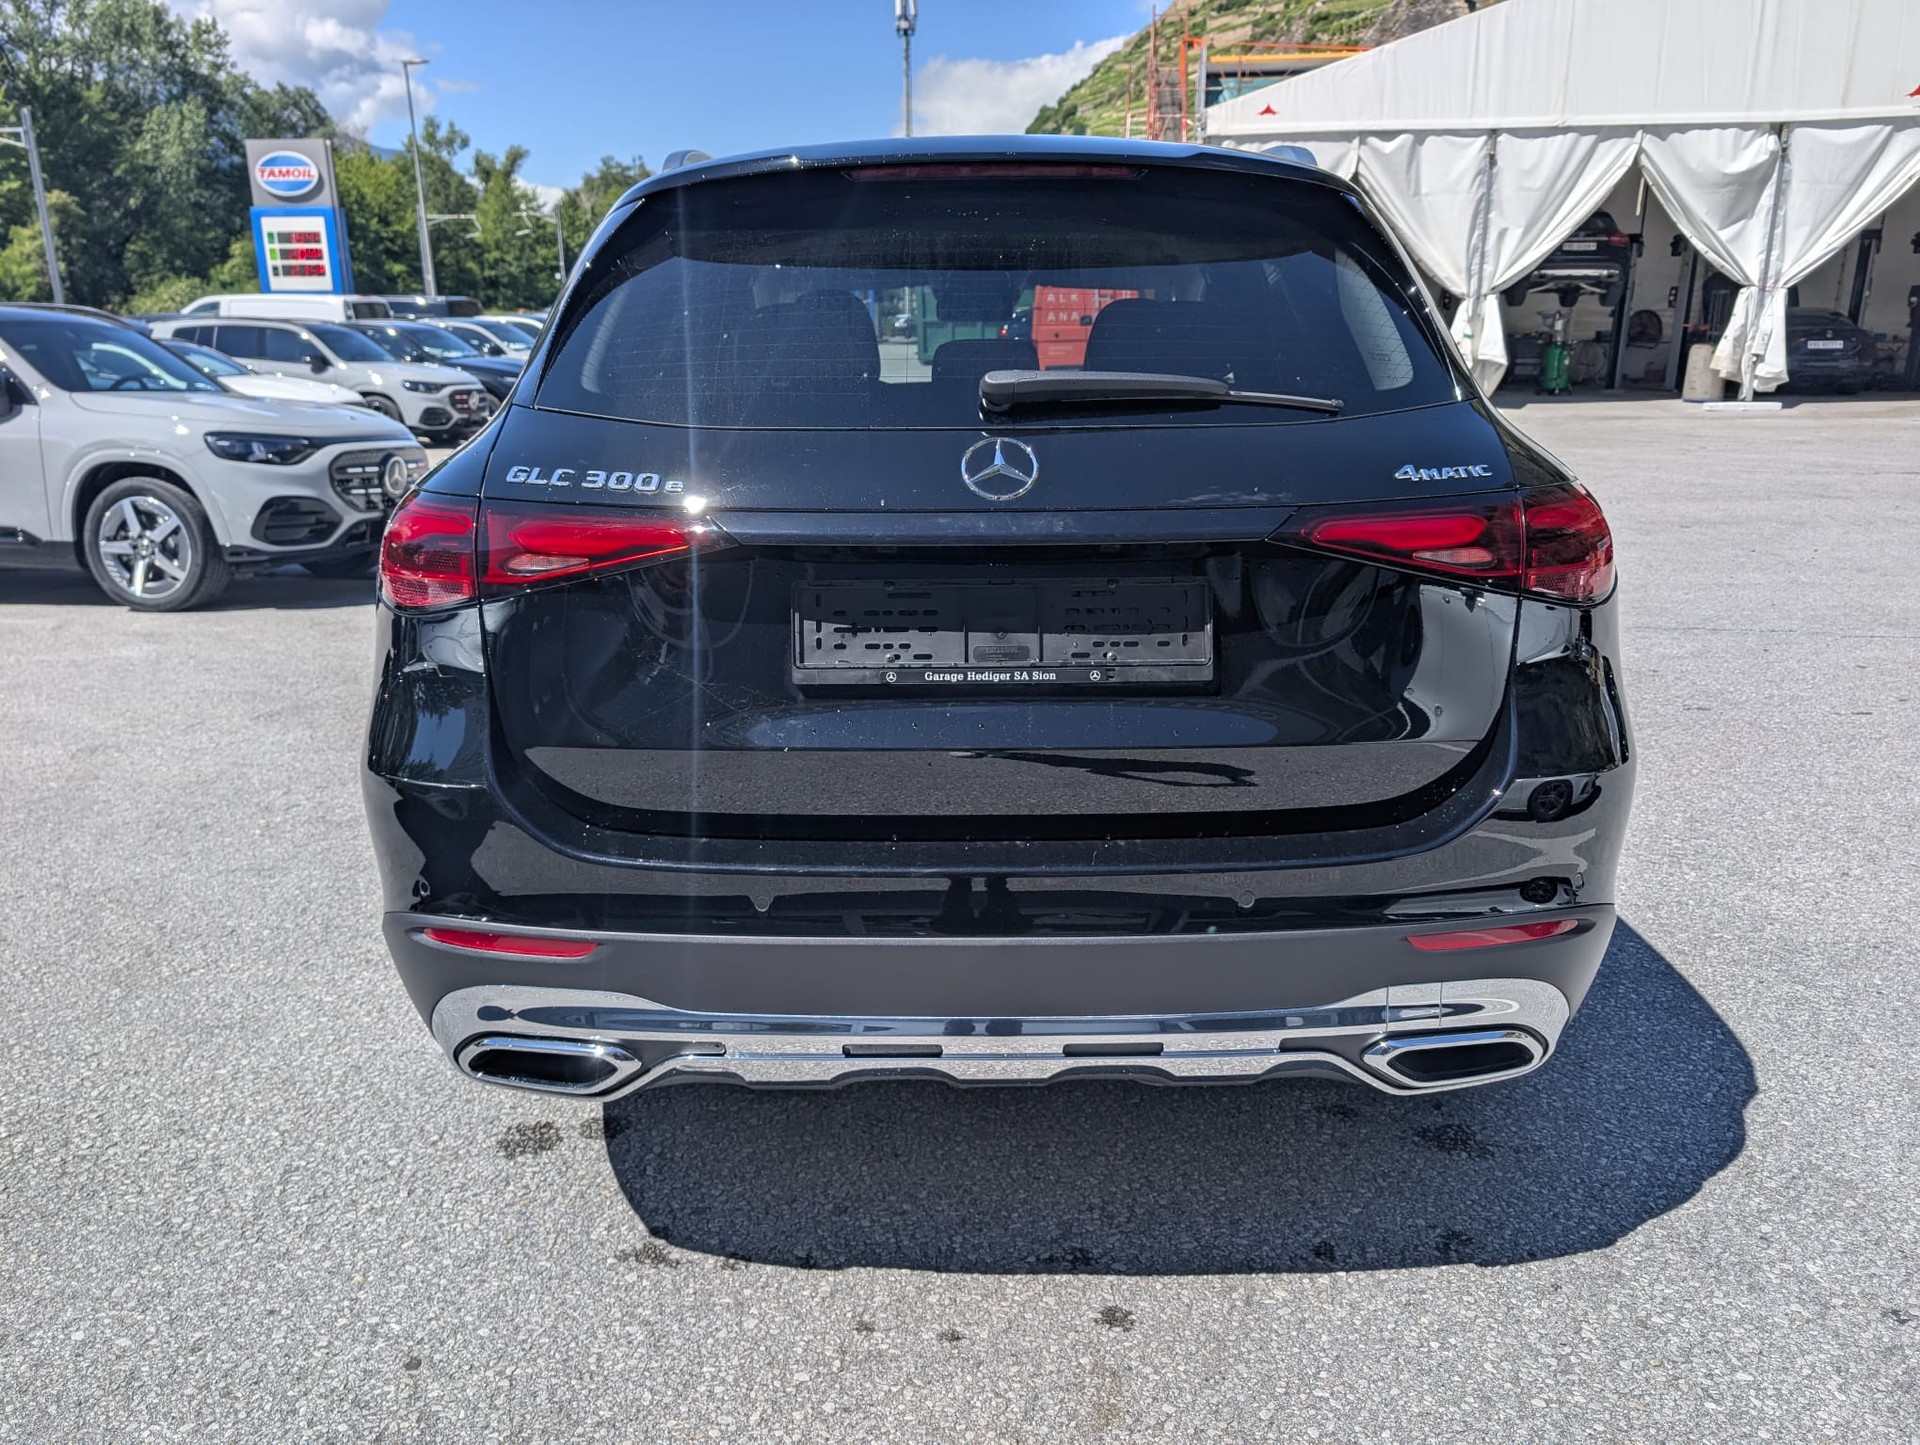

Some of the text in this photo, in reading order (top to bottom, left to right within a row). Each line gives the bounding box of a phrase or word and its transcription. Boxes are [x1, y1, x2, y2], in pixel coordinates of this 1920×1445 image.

[258, 168, 314, 179] TAMOIL
[506, 466, 574, 487] GLC
[1394, 464, 1493, 481] 4MATIC
[924, 671, 1057, 682] Garage Hediger SA Sion
